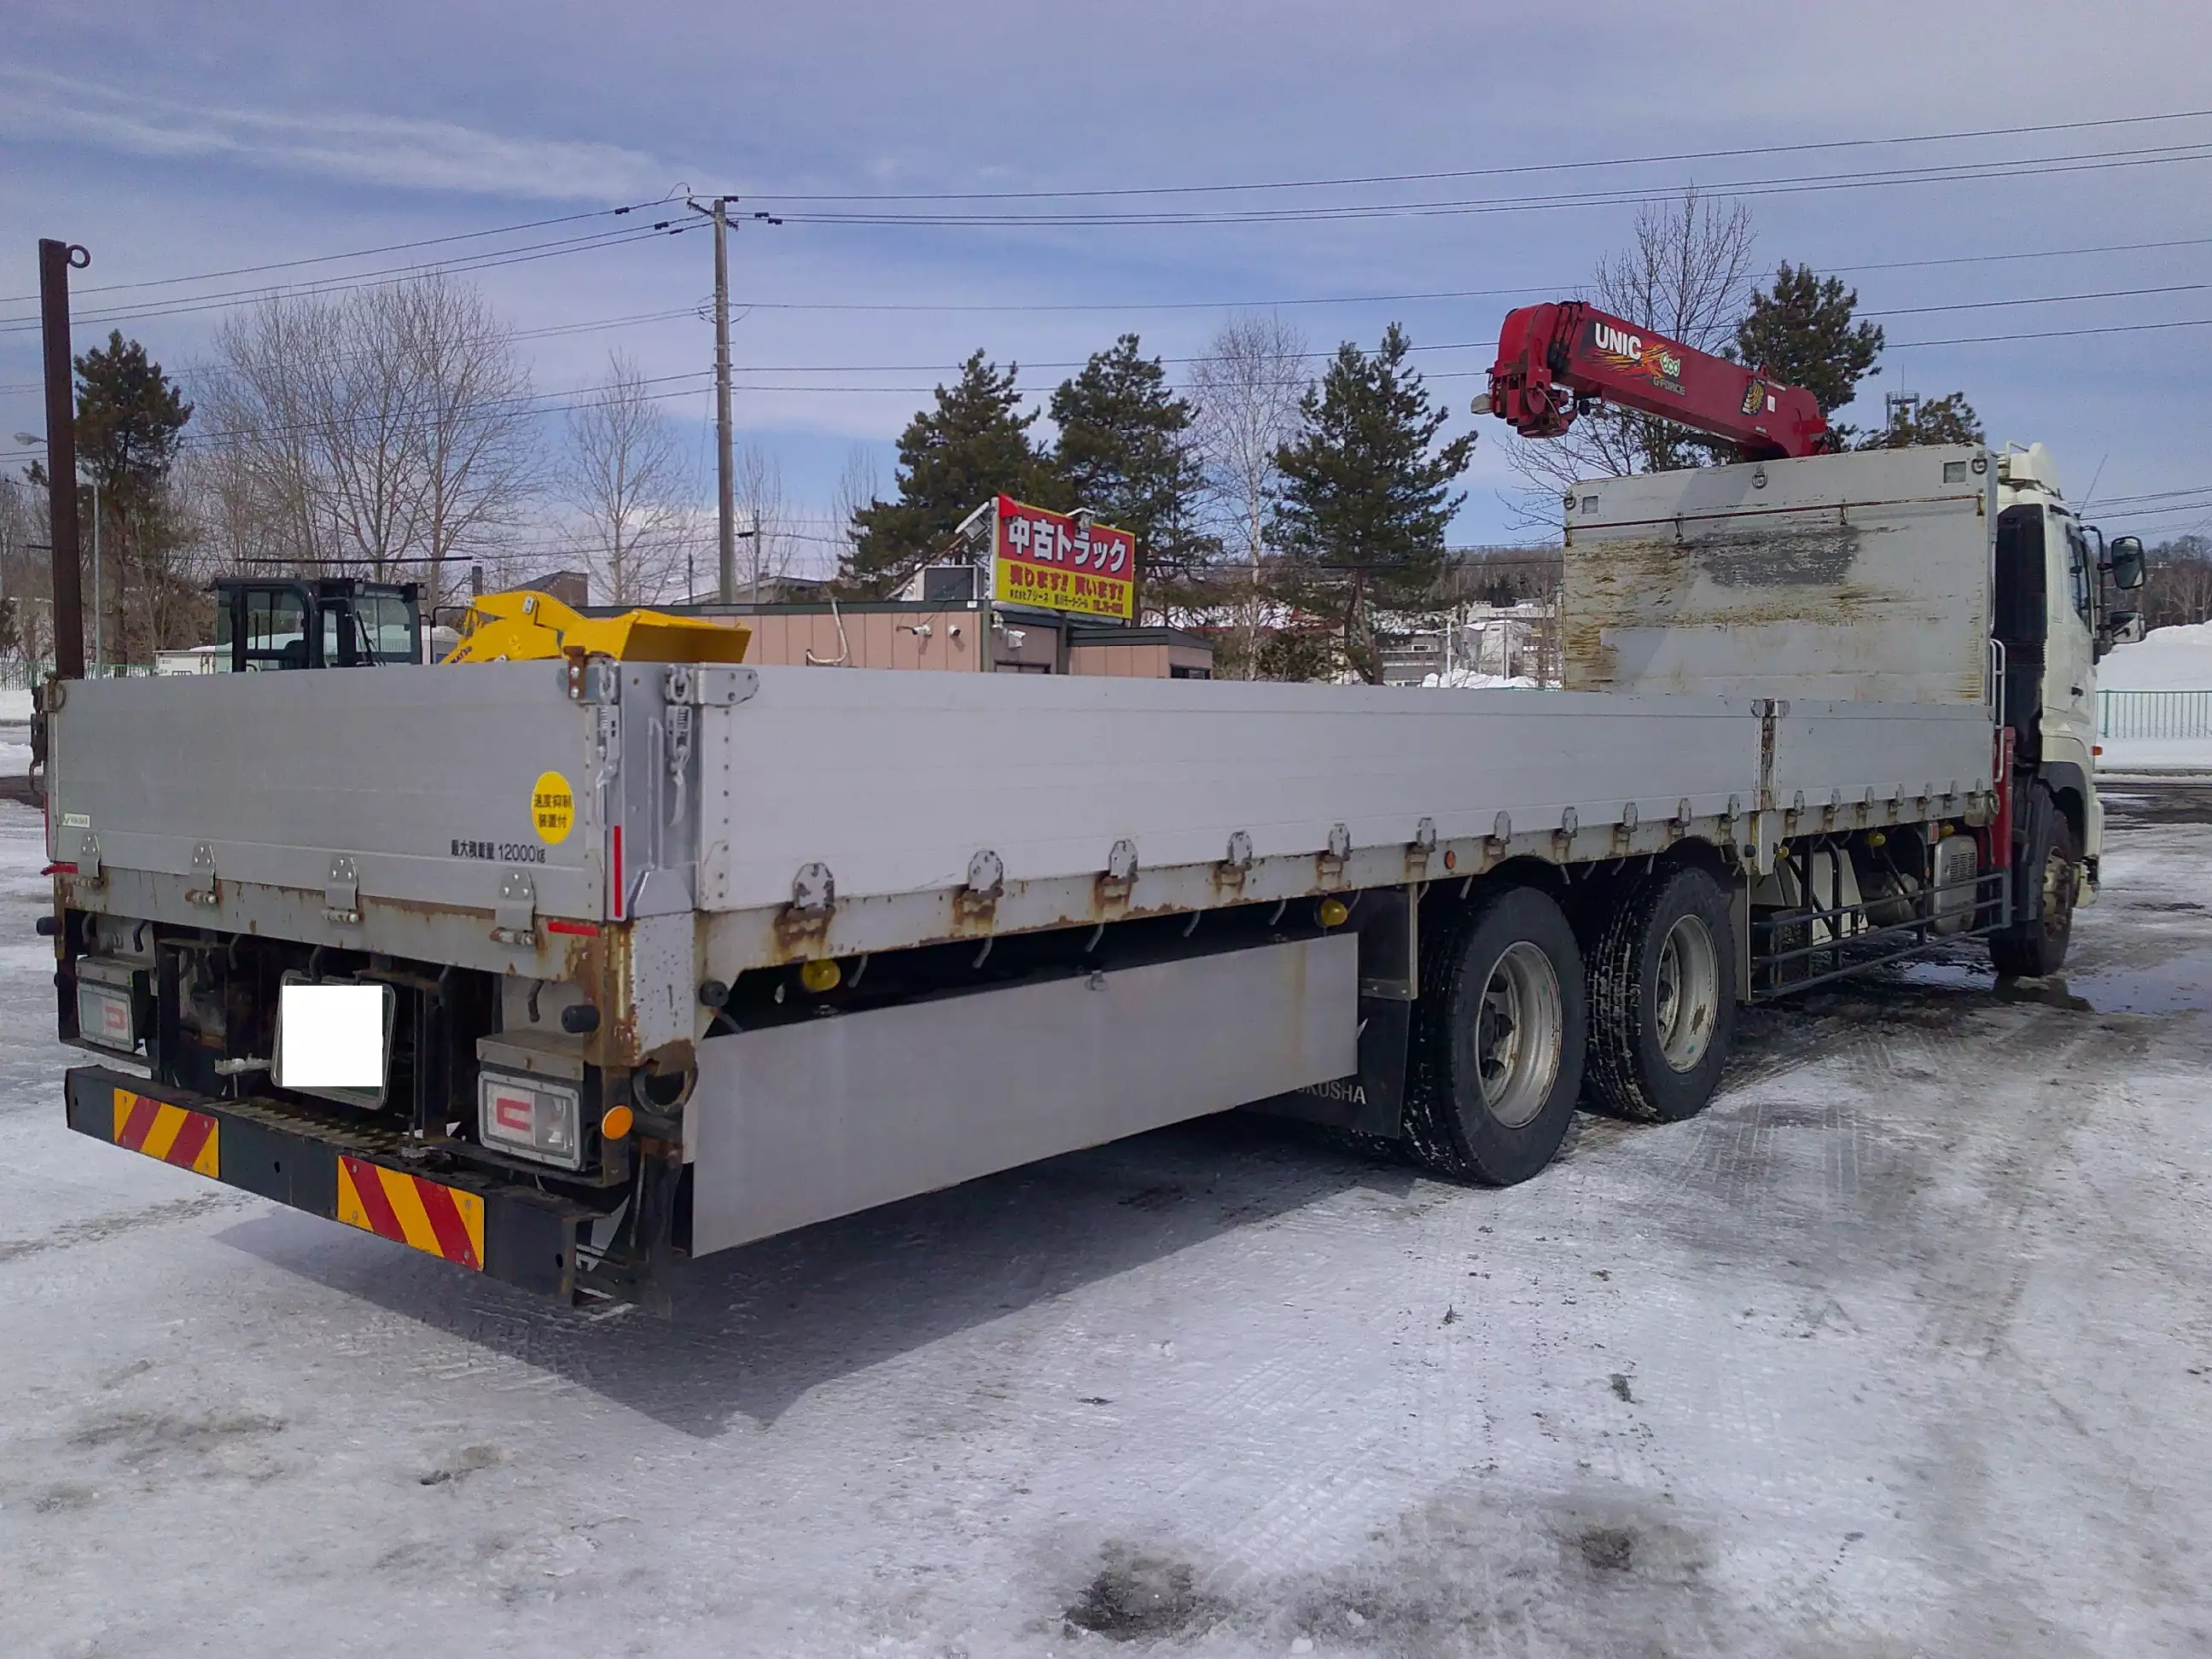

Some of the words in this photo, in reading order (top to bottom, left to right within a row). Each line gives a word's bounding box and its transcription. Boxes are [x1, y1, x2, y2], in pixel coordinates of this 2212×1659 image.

[1594, 322, 1642, 361] UNIC
[1661, 352, 1681, 377] eco
[1008, 516, 1126, 572] 中古トラック
